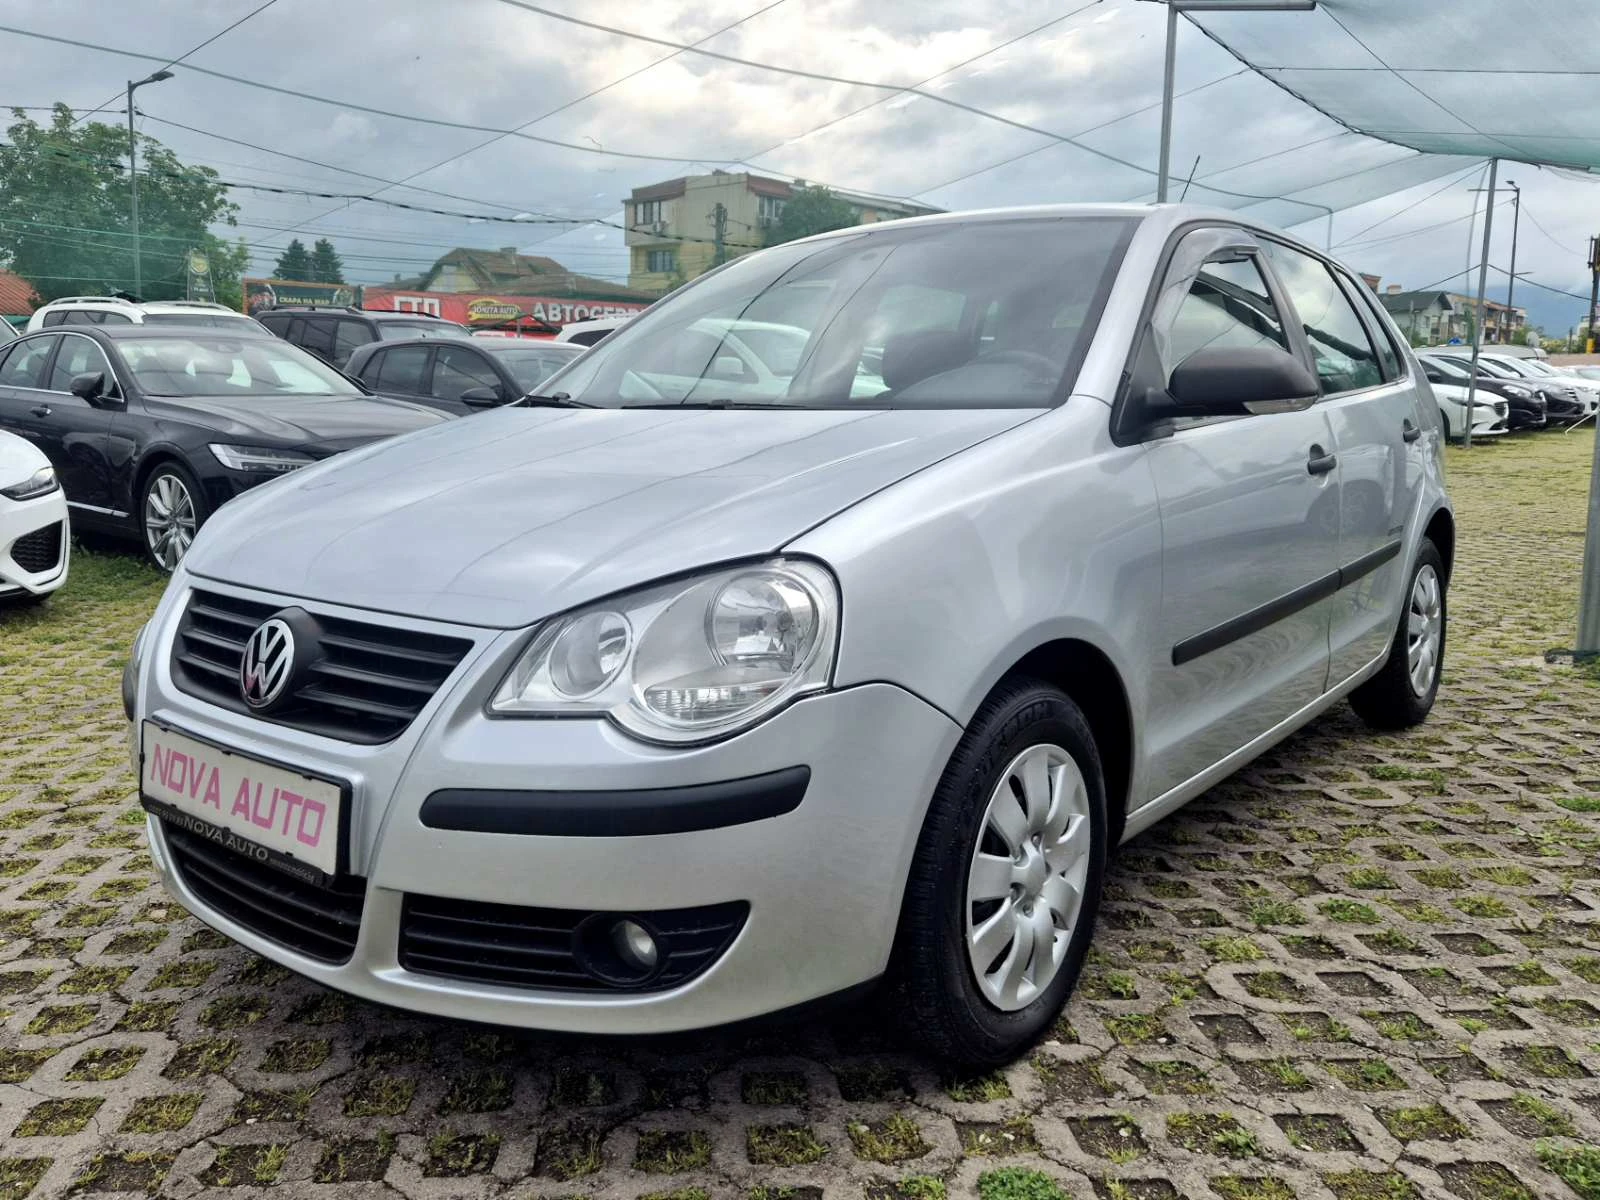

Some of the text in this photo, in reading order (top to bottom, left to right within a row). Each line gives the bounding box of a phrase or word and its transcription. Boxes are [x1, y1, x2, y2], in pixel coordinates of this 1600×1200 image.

[151, 743, 326, 848] NOVA AUTO
[184, 815, 224, 843] NOVA
[226, 836, 269, 861] AUTO
